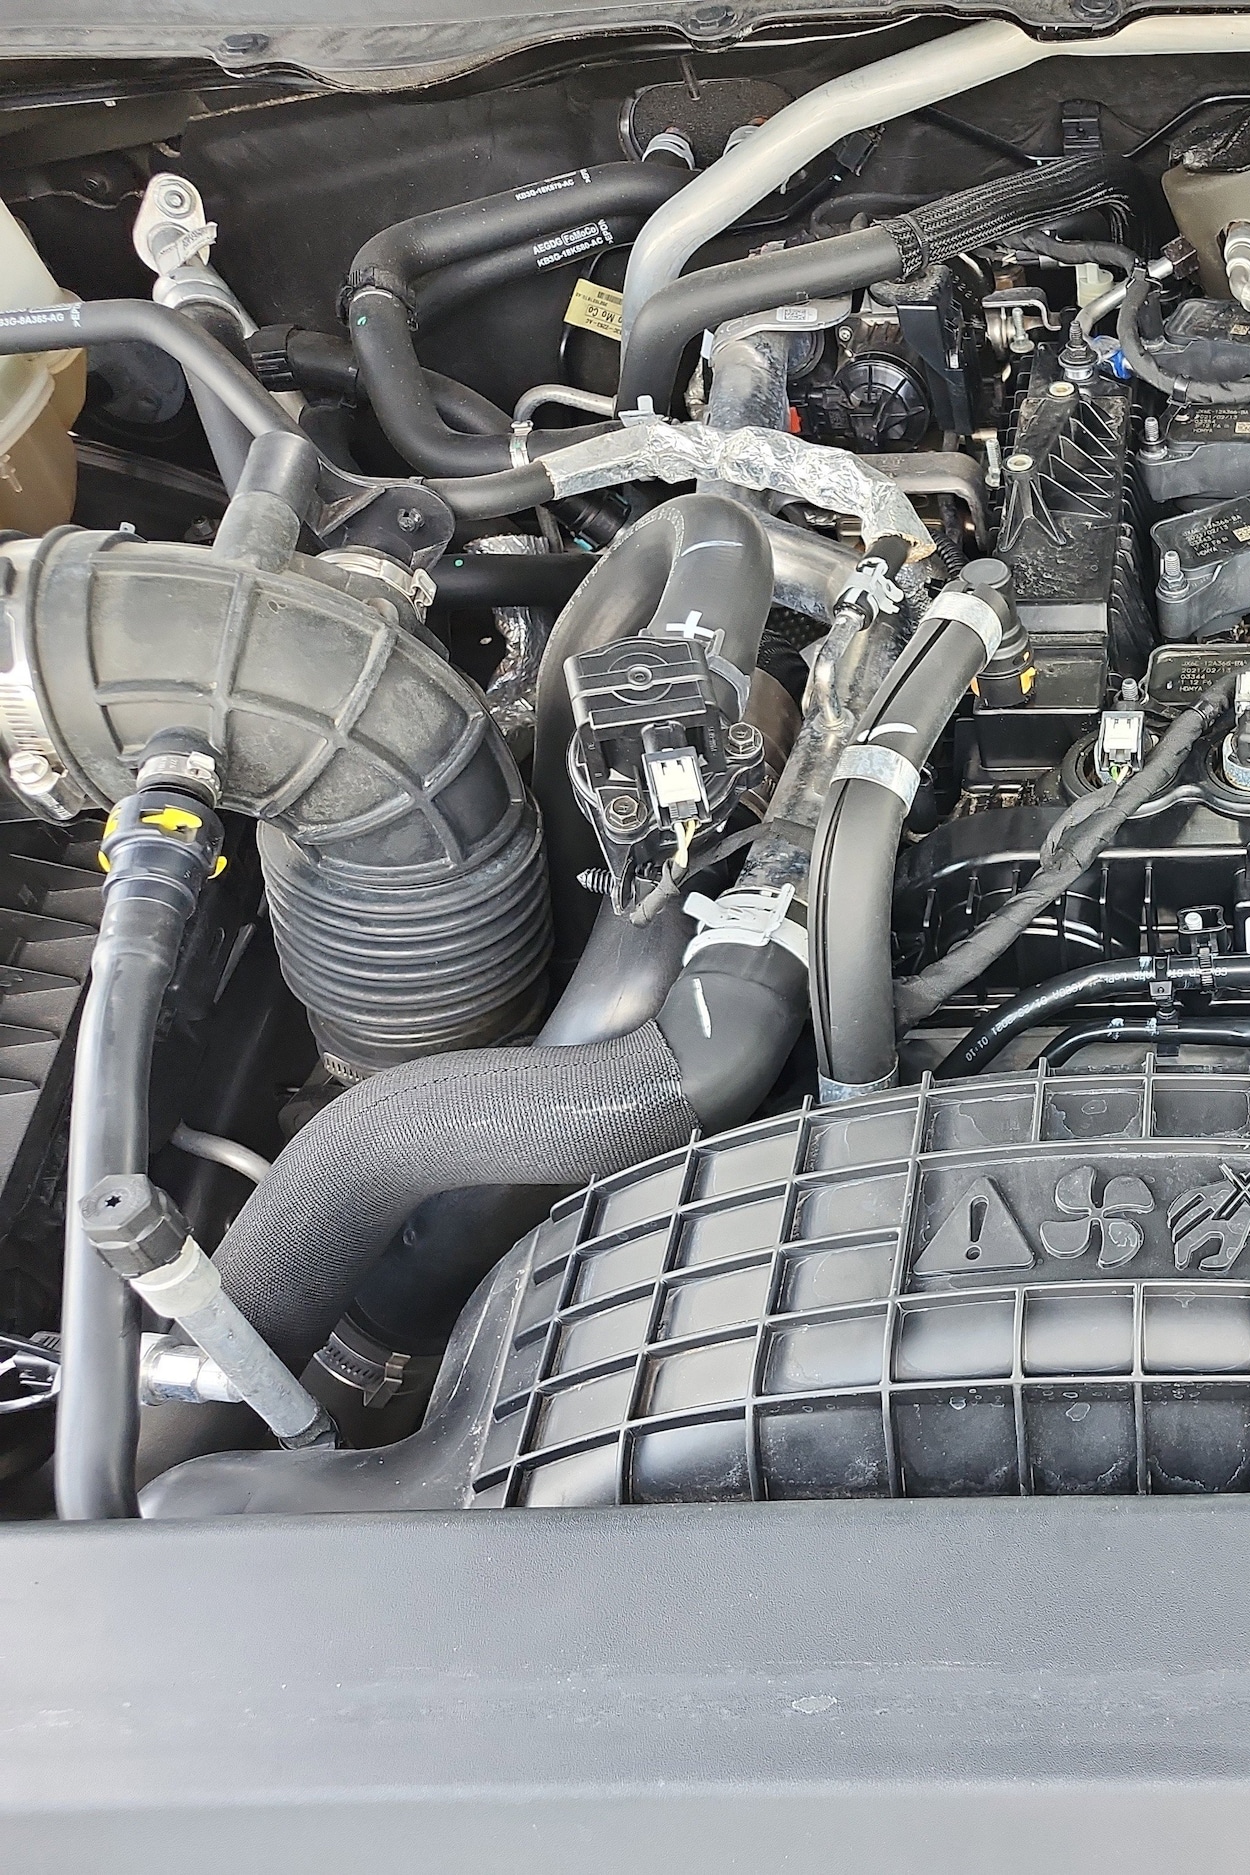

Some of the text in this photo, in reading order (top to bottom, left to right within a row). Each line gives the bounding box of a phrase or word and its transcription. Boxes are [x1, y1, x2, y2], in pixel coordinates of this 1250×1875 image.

[563, 225, 596, 244] FoMoCo
[588, 306, 599, 317] Co
[964, 1036, 989, 1063] 01:10
